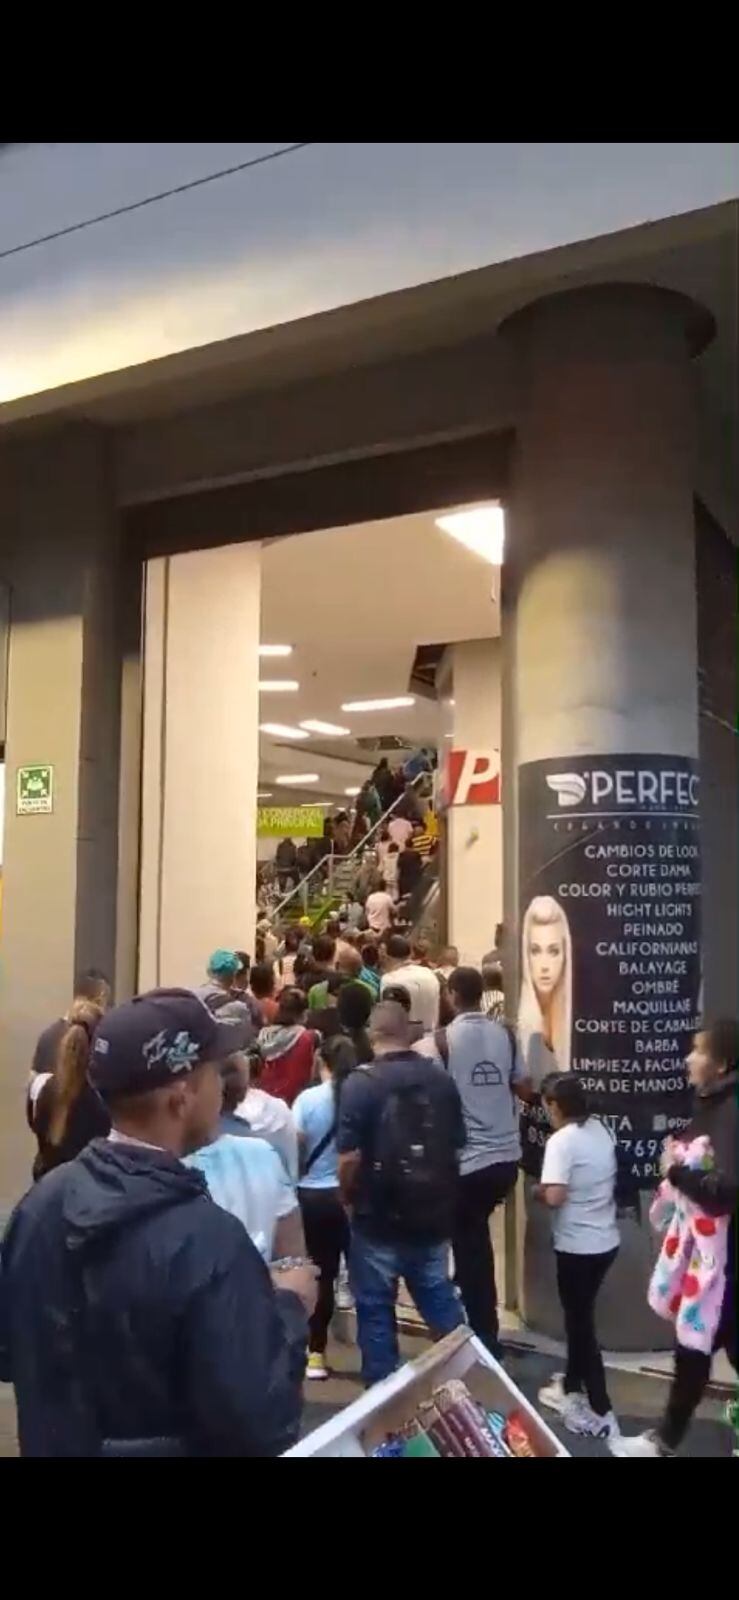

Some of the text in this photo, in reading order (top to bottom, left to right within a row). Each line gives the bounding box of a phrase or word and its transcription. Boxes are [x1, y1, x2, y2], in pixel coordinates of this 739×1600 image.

[584, 844, 655, 859] CAMBIOS
[658, 844, 674, 859] DE
[606, 863, 691, 878] CORTE DAMA
[558, 883, 611, 897] COLOR
[616, 883, 626, 896] Y
[629, 882, 673, 897] RUBIO
[606, 902, 692, 917] HIGHT LIGHTS
[623, 922, 684, 936] PEINADO
[595, 941, 698, 957] CALIFORNIANAS
[619, 959, 687, 975] BALAYAGE
[612, 998, 692, 1015] MAQUILLAJE
[574, 1018, 626, 1034] CORTE
[630, 1018, 651, 1034] DE
[634, 1039, 680, 1054] BARBA
[572, 1058, 641, 1073] LIMPIEZA
[579, 1076, 684, 1093] SPA DE MANOS
